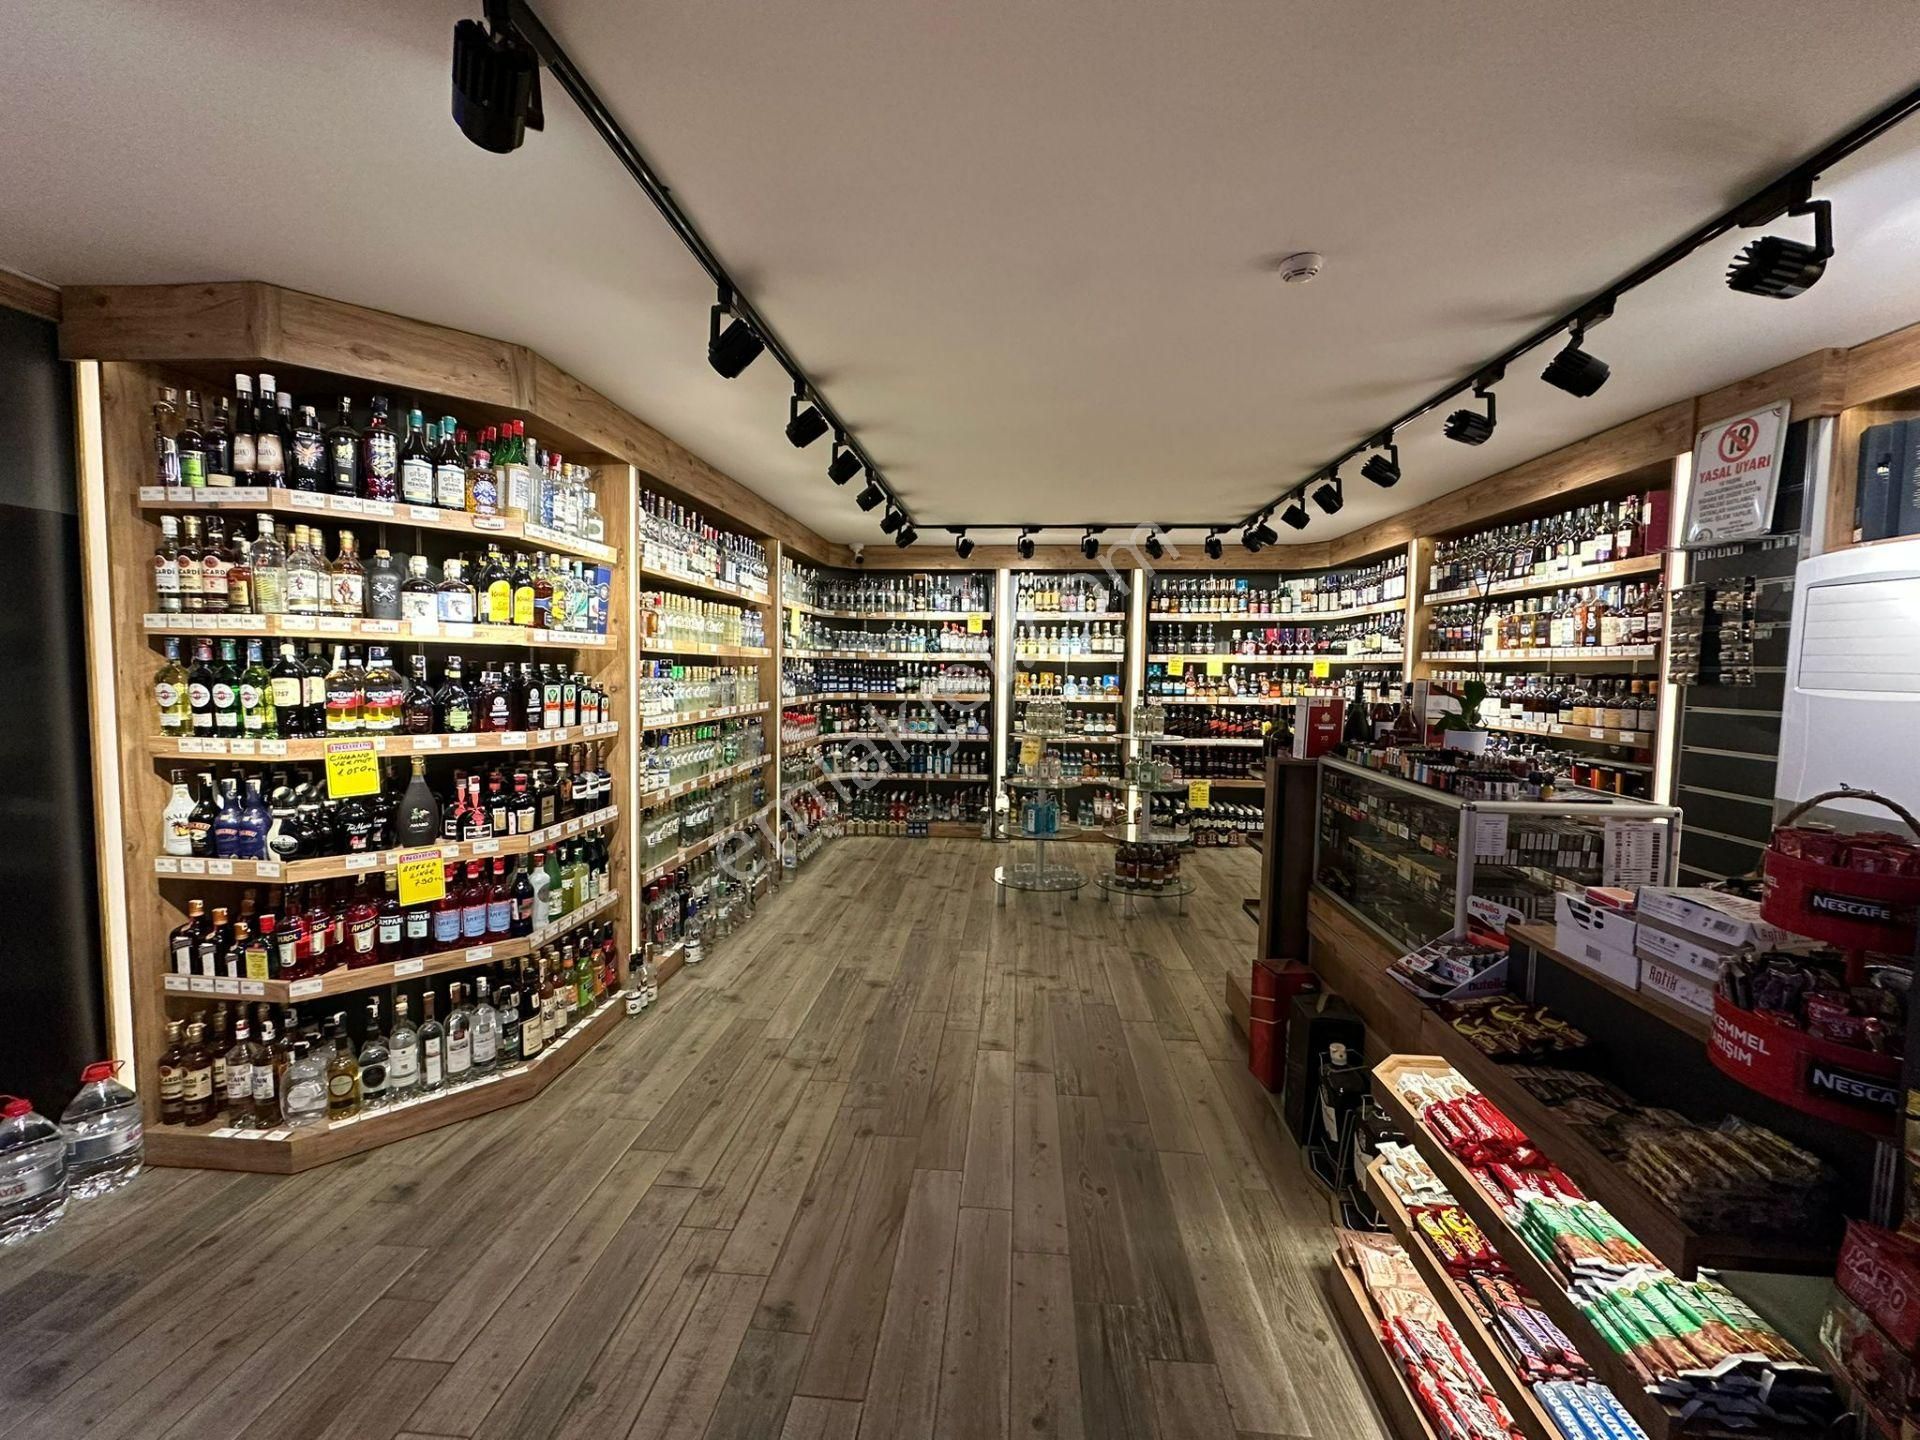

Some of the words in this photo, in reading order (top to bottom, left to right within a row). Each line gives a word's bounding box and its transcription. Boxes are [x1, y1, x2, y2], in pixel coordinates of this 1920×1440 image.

[1700, 465, 1731, 483] YASAL
[1735, 454, 1771, 474] UYARI
[1472, 901, 1500, 915] nutella
[351, 919, 377, 933] APEROL
[378, 914, 404, 926] AMPARI
[1714, 1015, 1771, 1056] KEMMEL
[1813, 1068, 1897, 1106] NESCA
